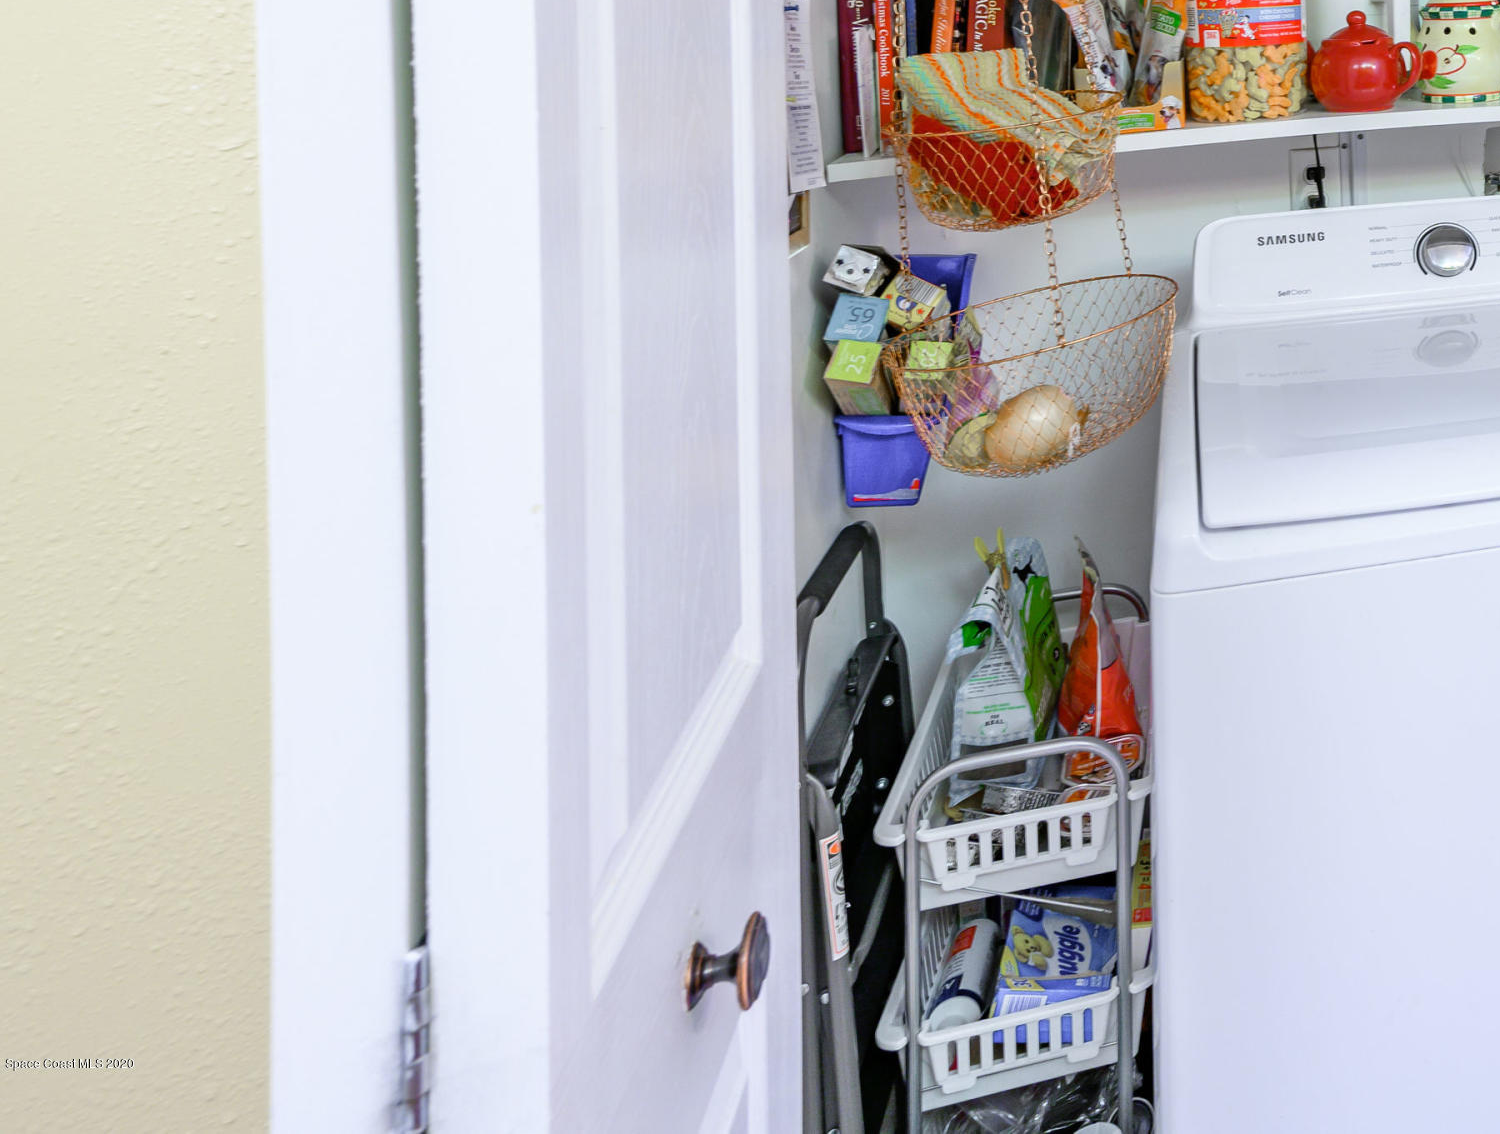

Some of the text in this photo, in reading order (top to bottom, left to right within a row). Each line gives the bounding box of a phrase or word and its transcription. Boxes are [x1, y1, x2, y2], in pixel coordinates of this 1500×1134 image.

[974, 32, 984, 40] In
[878, 29, 889, 77] Cookbook
[1257, 231, 1325, 247] SAMSUNG
[845, 355, 866, 374] 25
